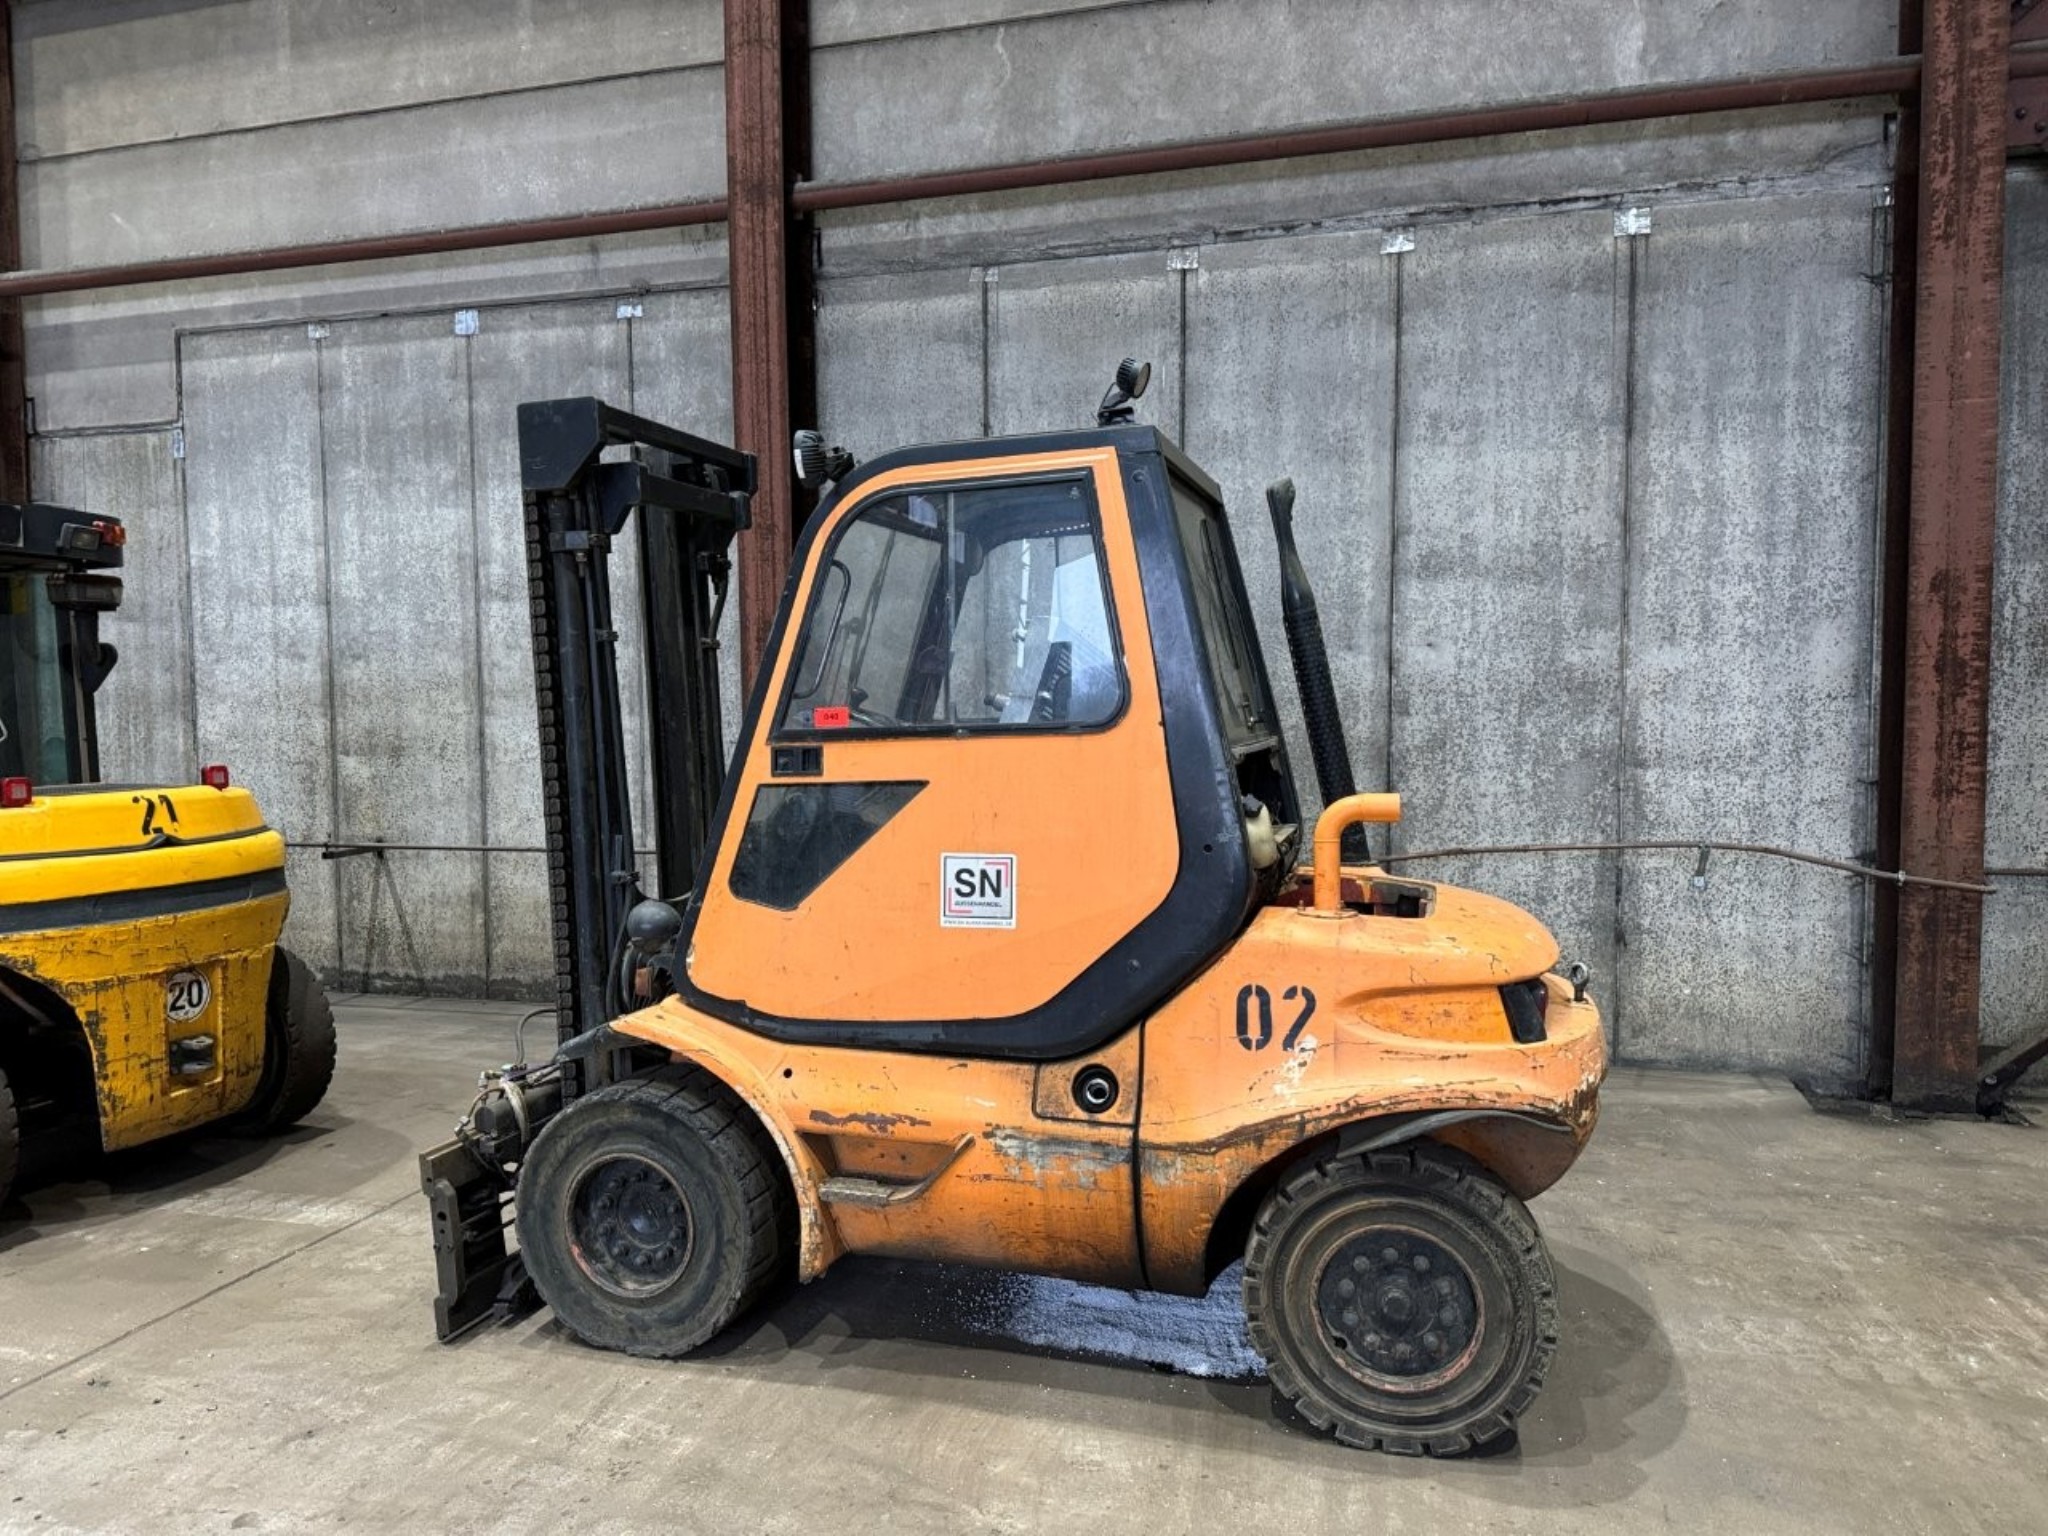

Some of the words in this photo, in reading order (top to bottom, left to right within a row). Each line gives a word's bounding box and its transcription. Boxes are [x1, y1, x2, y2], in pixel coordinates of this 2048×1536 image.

[131, 794, 179, 836] 21
[954, 867, 1002, 898] SN
[168, 979, 204, 1012] 20
[1236, 984, 1317, 1052] 02
